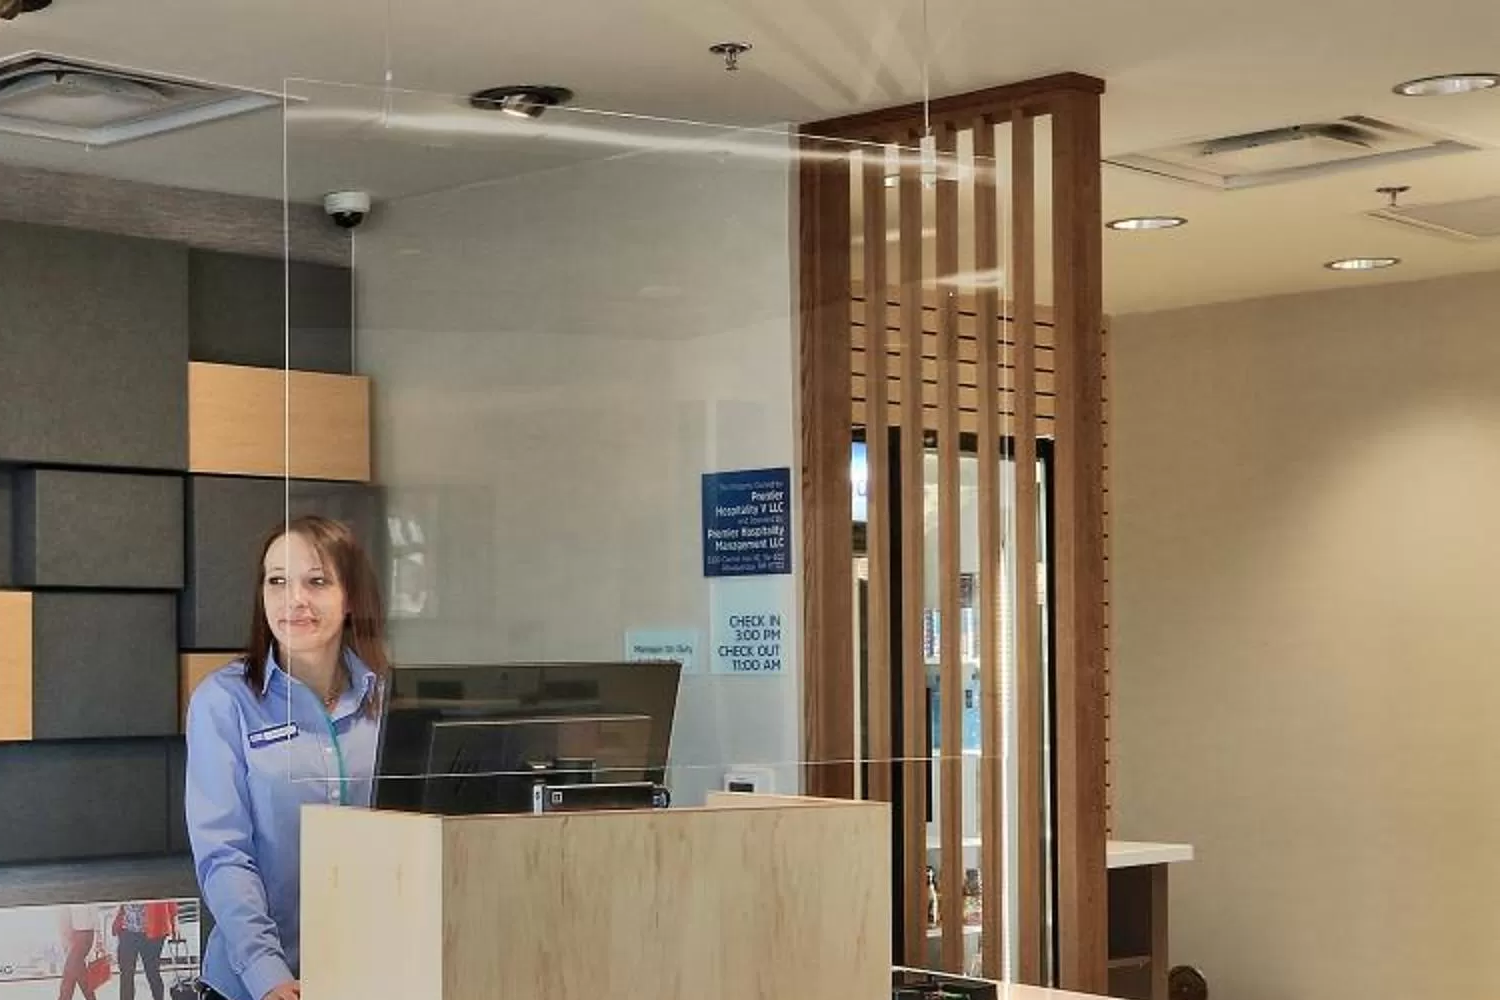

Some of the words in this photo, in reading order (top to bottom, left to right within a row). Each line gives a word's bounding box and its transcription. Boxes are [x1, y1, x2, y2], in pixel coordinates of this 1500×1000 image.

[751, 490, 784, 502] Premier
[715, 504, 759, 517] Hospitality
[769, 501, 784, 513] LLC
[707, 528, 739, 540] Premier
[741, 525, 785, 537] Hospitality
[715, 539, 768, 552] Management
[769, 537, 785, 548] LLC
[729, 615, 765, 628] CHECK
[769, 615, 781, 627] IN
[735, 629, 760, 641] 3:00
[764, 629, 781, 640] PM
[717, 645, 754, 657] CHECK
[758, 644, 780, 657] OUT
[733, 660, 760, 672] 11:00
[764, 660, 781, 671] AM
